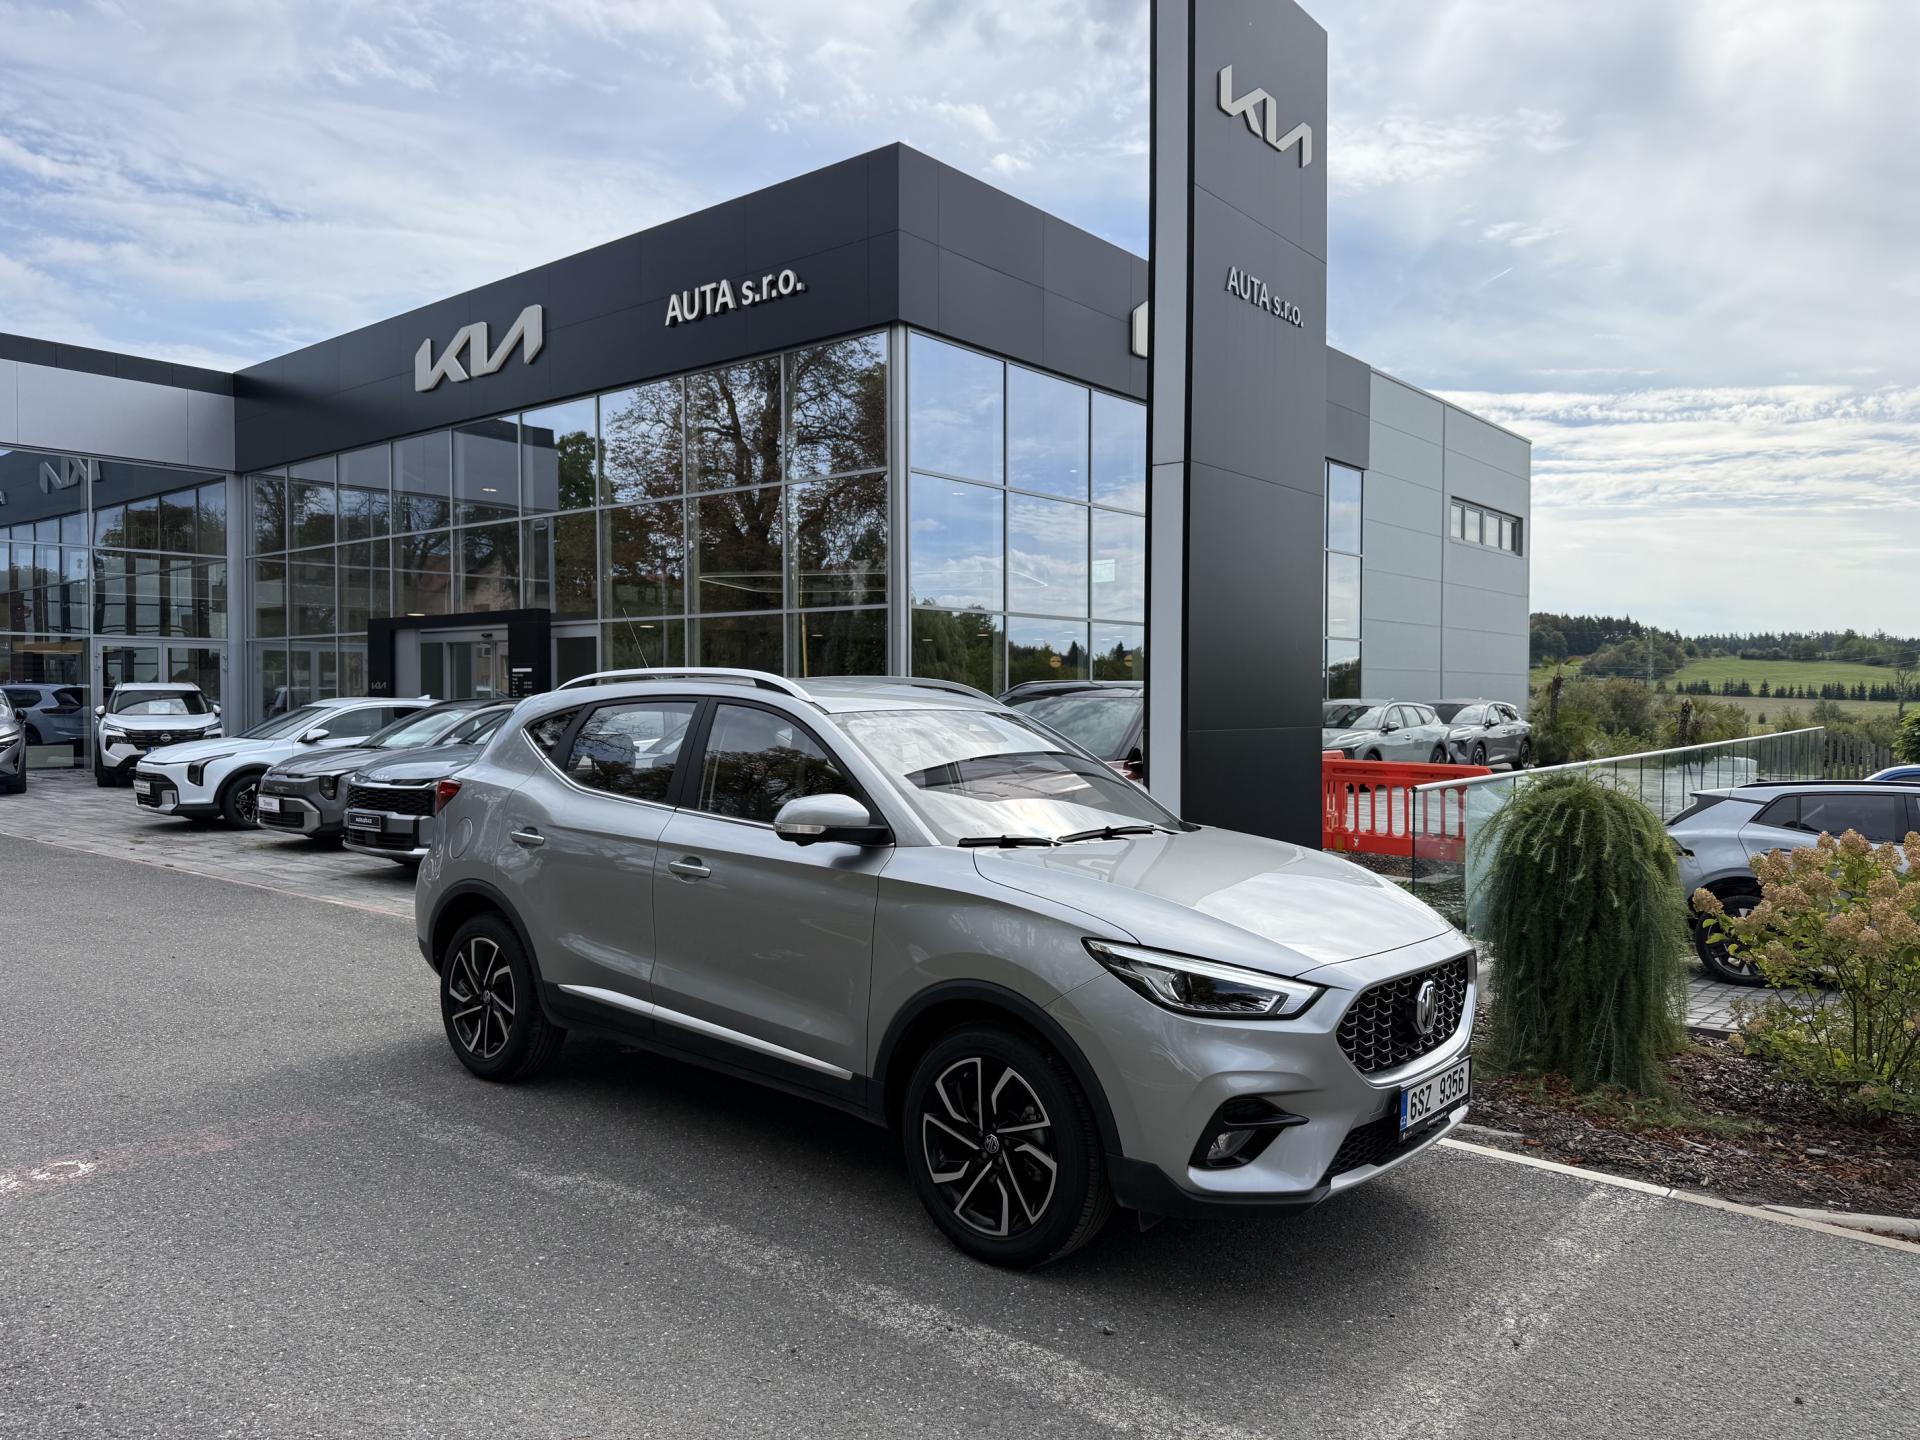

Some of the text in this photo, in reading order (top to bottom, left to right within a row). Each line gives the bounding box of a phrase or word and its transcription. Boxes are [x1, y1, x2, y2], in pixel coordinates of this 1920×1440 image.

[1217, 64, 1312, 168] KIA
[665, 268, 804, 326] AUTA s.r.o.
[1226, 266, 1304, 327] AUTA s.r.o.
[414, 303, 543, 392] KIA
[1410, 1084, 1432, 1120] 6SZ
[1439, 1067, 1465, 1105] 9356
